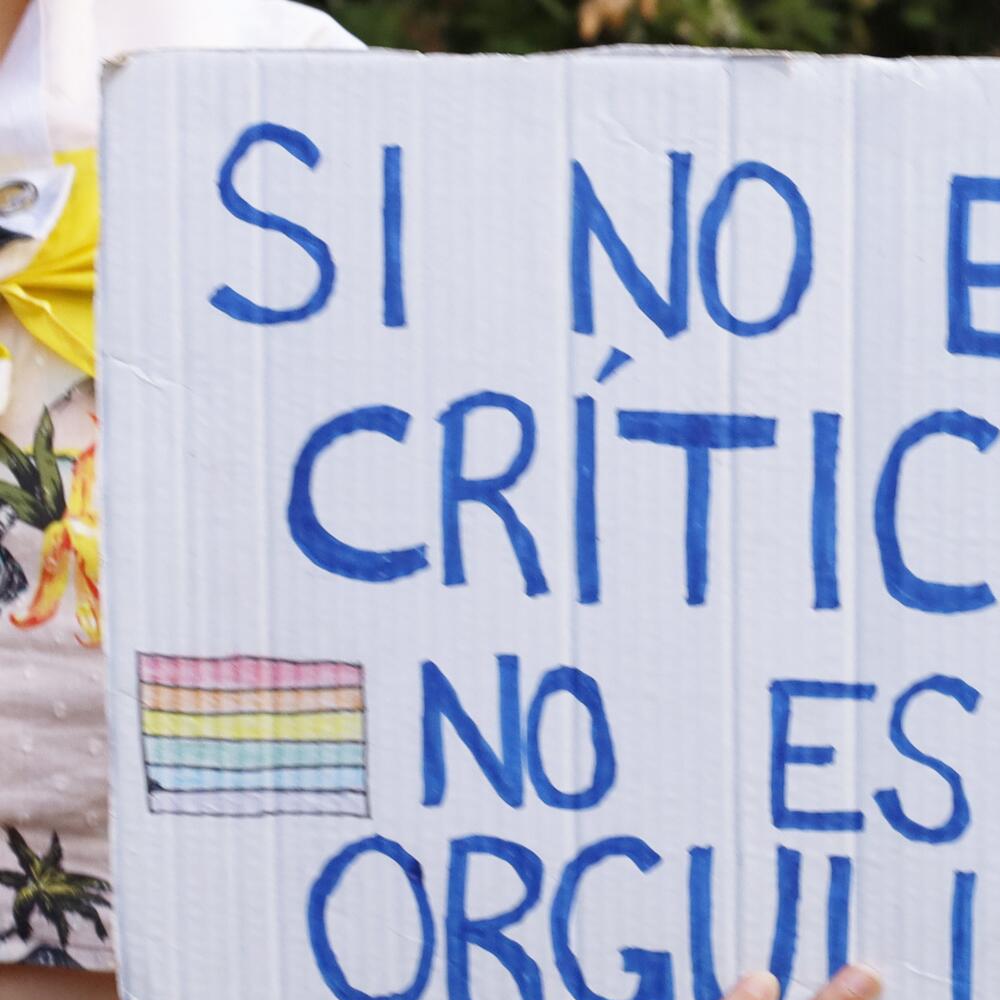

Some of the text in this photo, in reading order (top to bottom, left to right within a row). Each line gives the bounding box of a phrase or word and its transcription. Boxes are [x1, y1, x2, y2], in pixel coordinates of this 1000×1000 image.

[209, 121, 407, 328] SI
[570, 150, 814, 339] NO
[421, 653, 982, 845] NO ES
